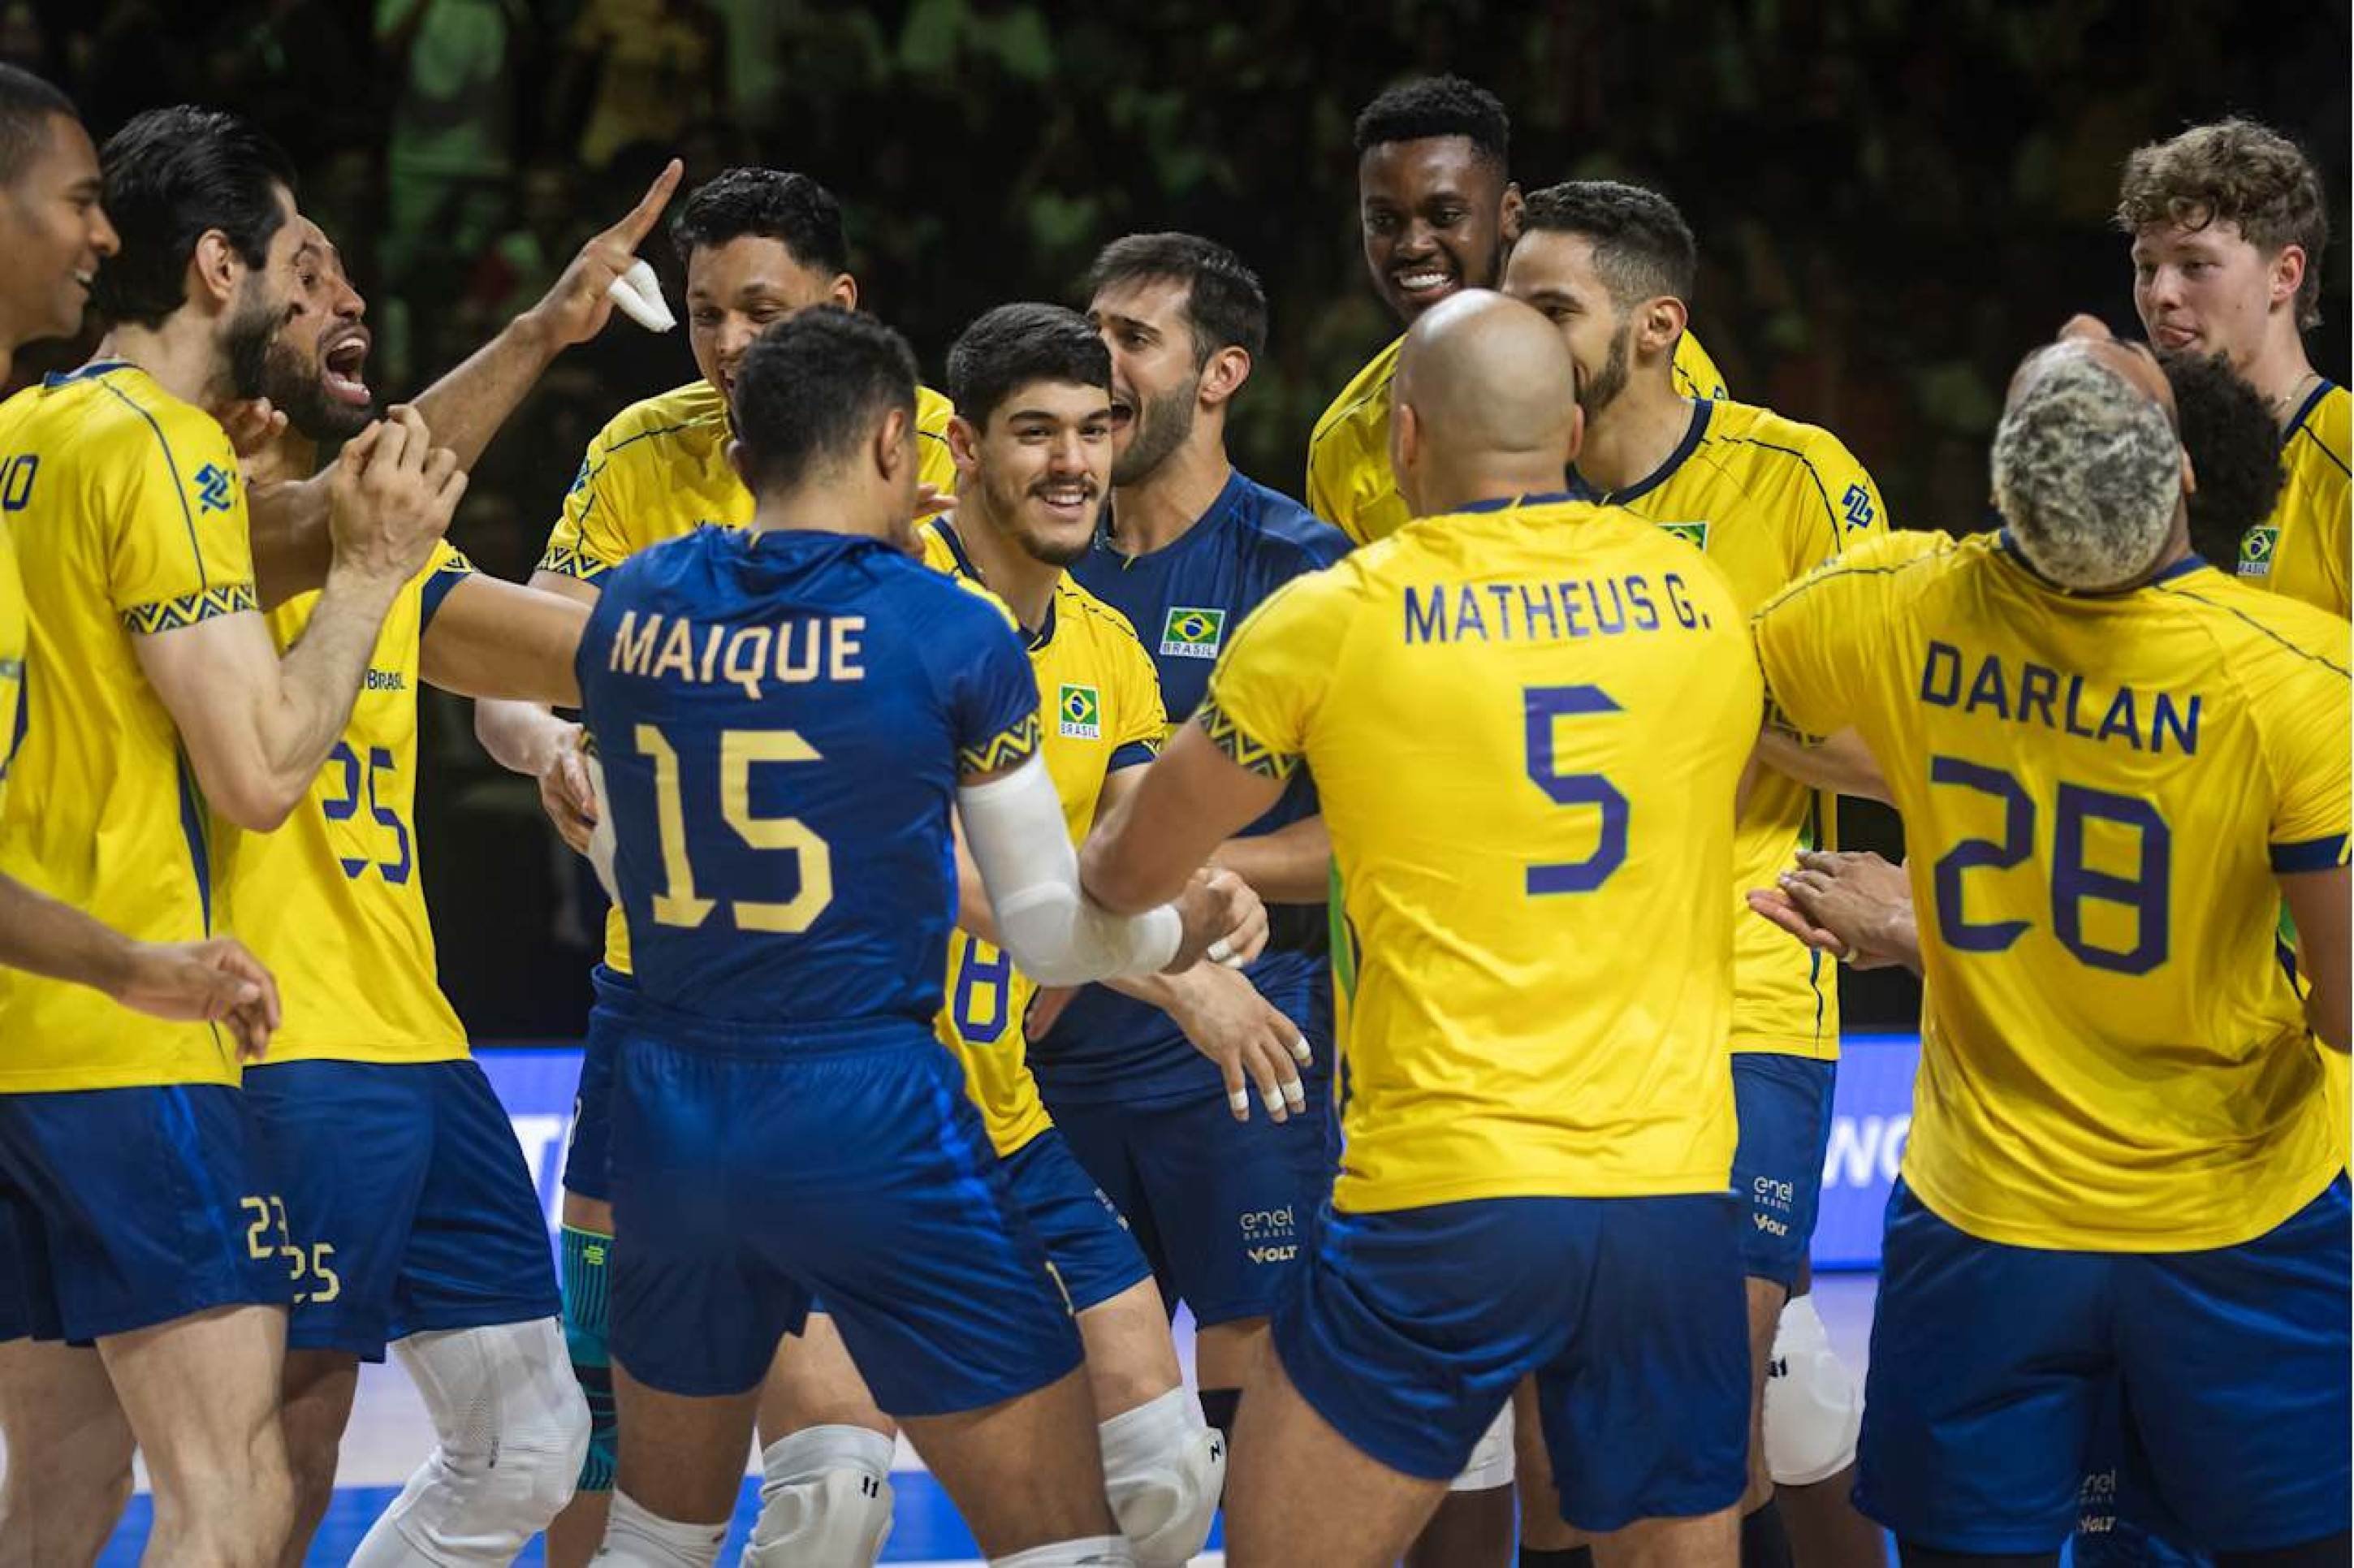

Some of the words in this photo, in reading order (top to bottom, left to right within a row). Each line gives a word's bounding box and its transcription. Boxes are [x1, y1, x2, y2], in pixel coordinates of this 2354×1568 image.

[1405, 574, 1660, 646] MATHEUS
[1665, 572, 1711, 630] G.
[610, 611, 865, 700] MAIQUE
[1161, 642, 1216, 658] BRASIL
[1060, 723, 1099, 738] BRASIL
[1920, 640, 2202, 755] DARLAN
[322, 741, 411, 886] 25
[634, 724, 834, 934] 15
[1522, 684, 1631, 896] 5
[1929, 754, 2171, 976] 28
[954, 938, 1011, 1043] 8
[1241, 1205, 1295, 1231] enel
[1754, 1176, 1793, 1203] enel
[280, 1242, 340, 1304] 25
[1247, 1245, 1298, 1264] VOLT
